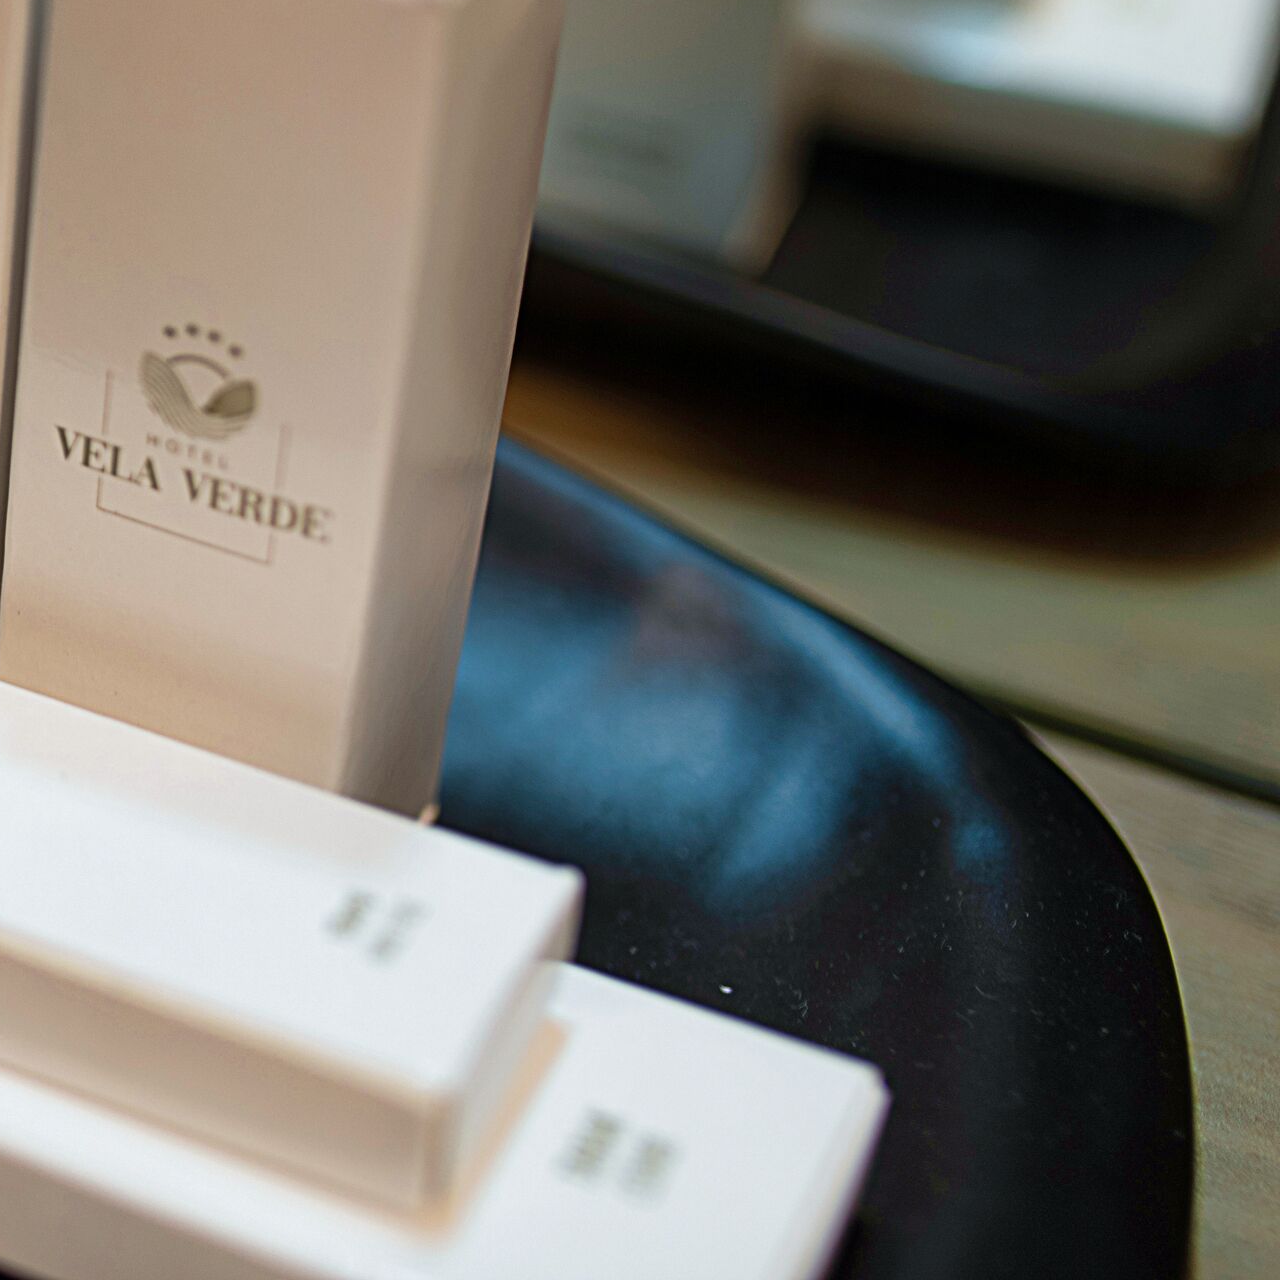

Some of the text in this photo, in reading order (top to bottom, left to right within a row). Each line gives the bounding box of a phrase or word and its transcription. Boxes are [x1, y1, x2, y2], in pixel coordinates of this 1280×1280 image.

[55, 425, 334, 544] VELA VERDE
[146, 432, 229, 470] HOTEL
